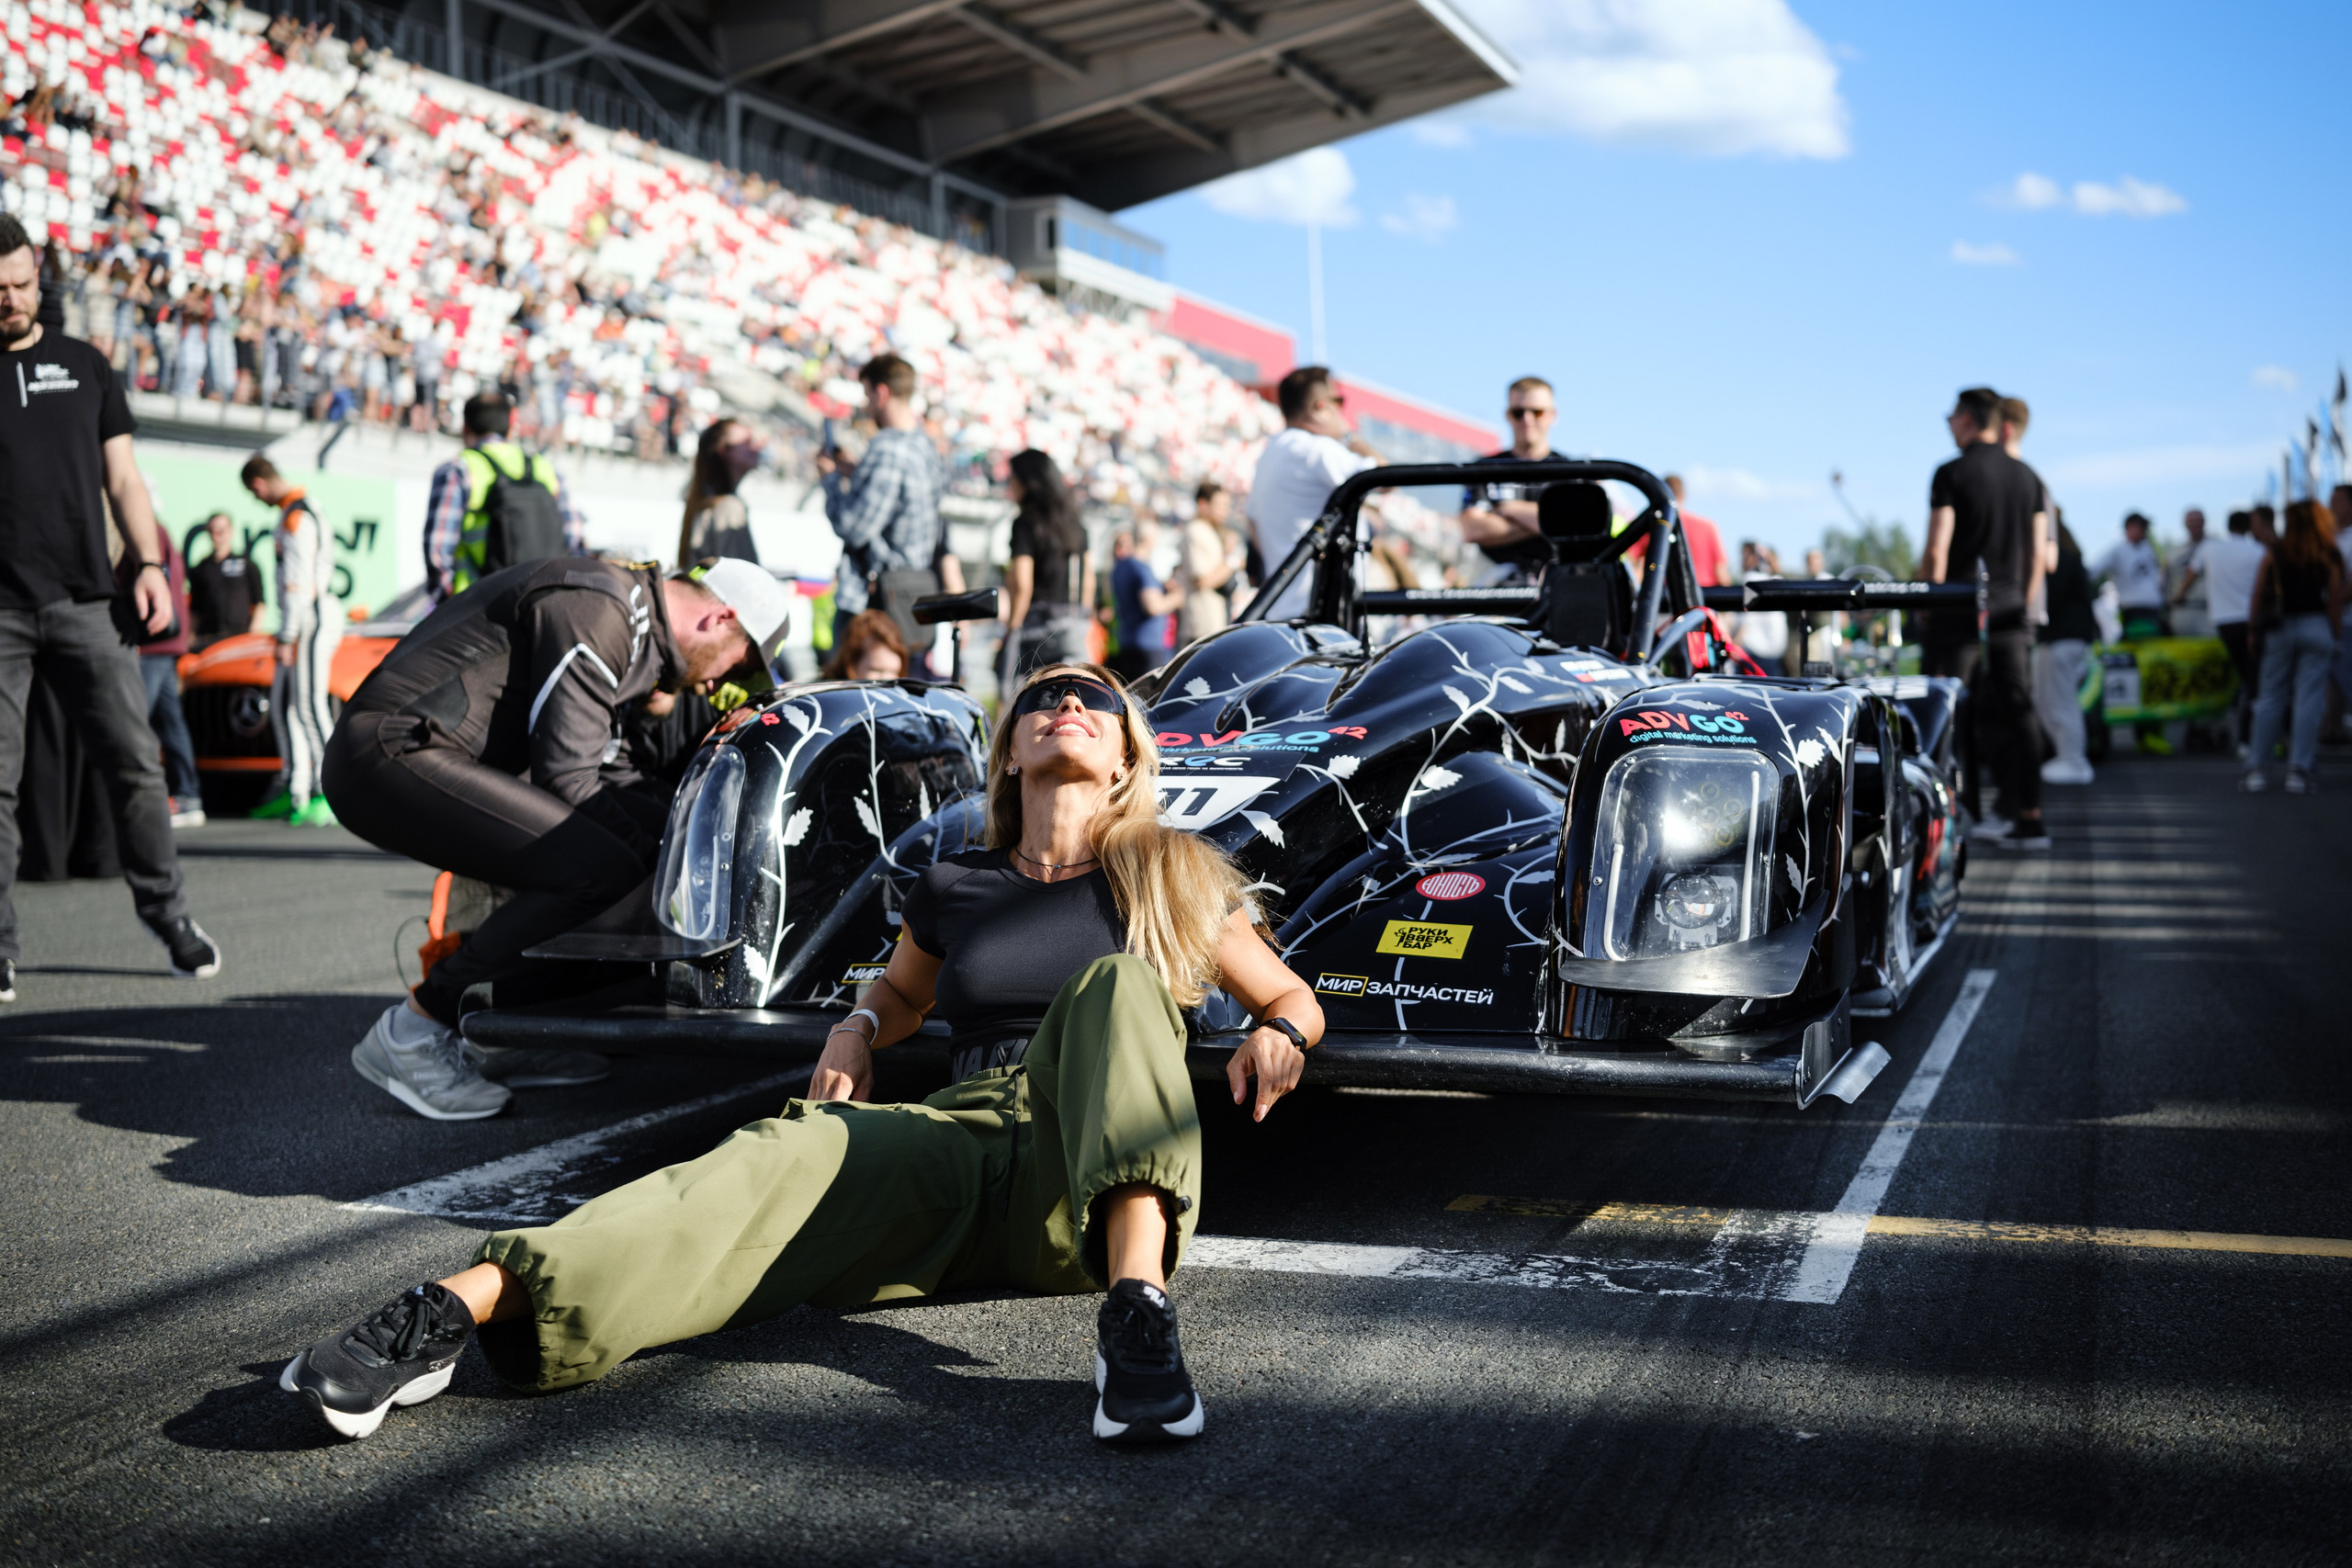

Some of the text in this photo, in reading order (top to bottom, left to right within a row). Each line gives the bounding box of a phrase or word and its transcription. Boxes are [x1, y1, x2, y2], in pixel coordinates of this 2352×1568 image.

[1620, 711, 1745, 737] ADVGO
[1153, 729, 1331, 748] DVGO
[1629, 730, 1758, 745] digital marketing solutions
[1408, 927, 1449, 936] РУКИ
[1402, 942, 1433, 950] БАР
[843, 967, 886, 980] МИР
[1316, 976, 1495, 1005] МИР ЗАПЧАСТЕЙ
